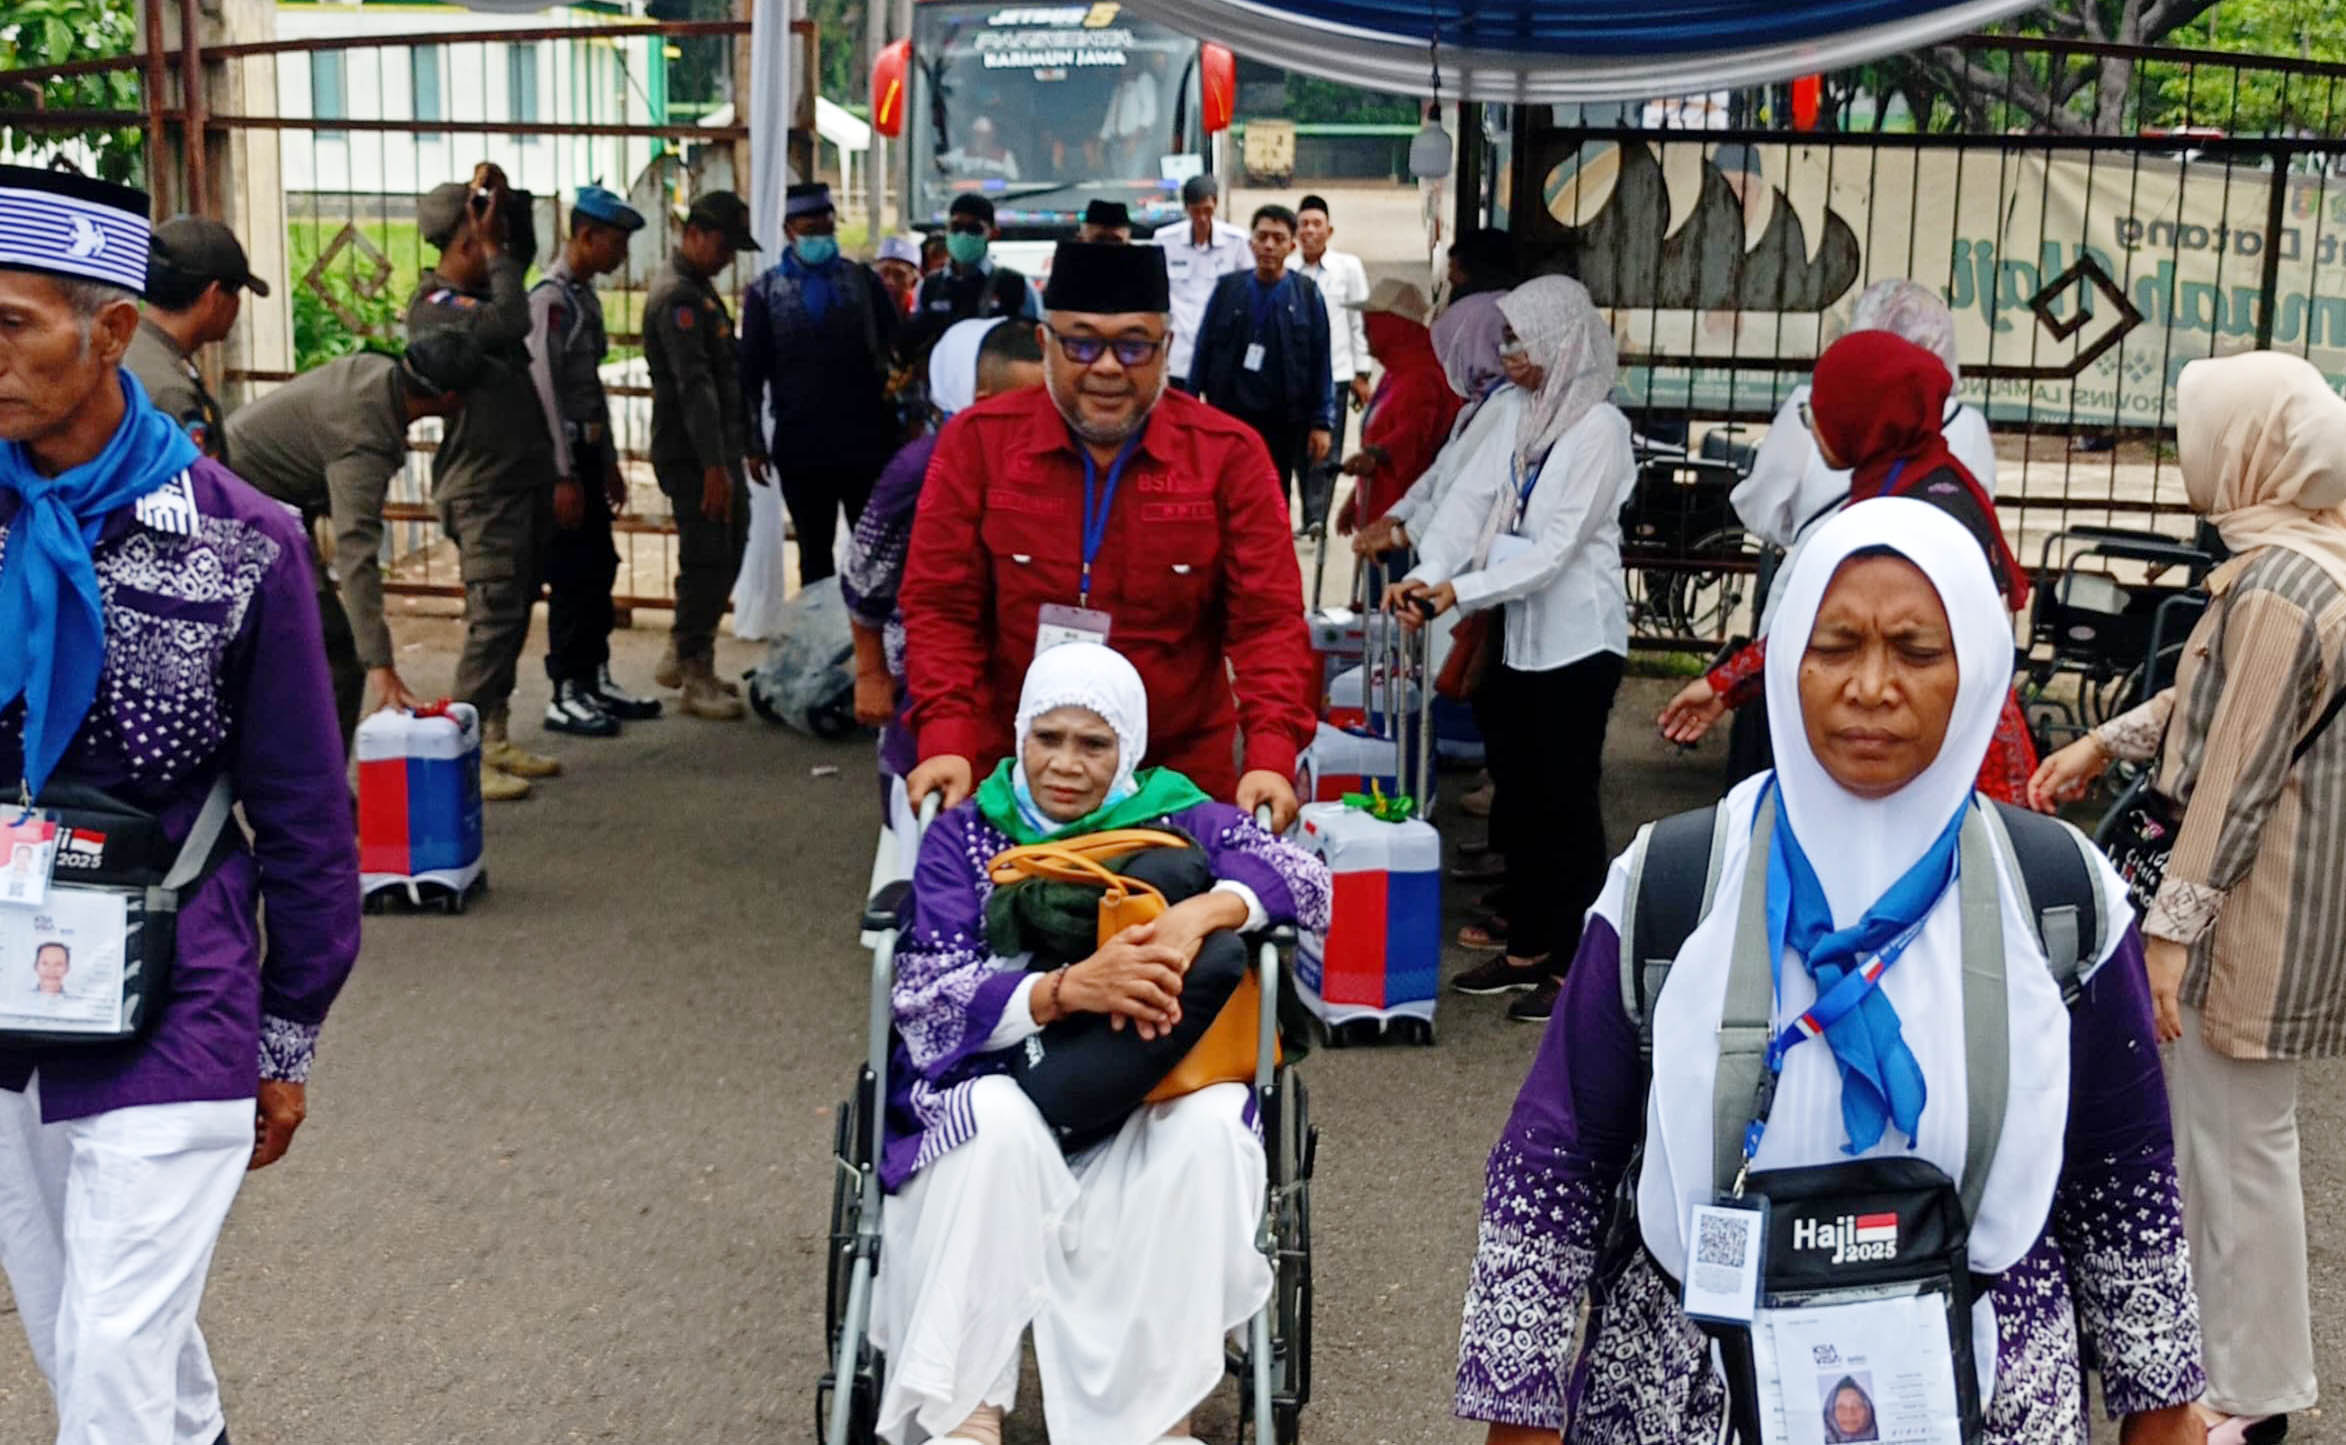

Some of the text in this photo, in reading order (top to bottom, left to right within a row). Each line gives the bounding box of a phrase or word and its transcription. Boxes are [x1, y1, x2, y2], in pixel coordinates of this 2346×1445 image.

[56, 852, 104, 869] 2025
[1793, 1215, 1856, 1265] Haji
[1845, 1240, 1898, 1262] 2025
